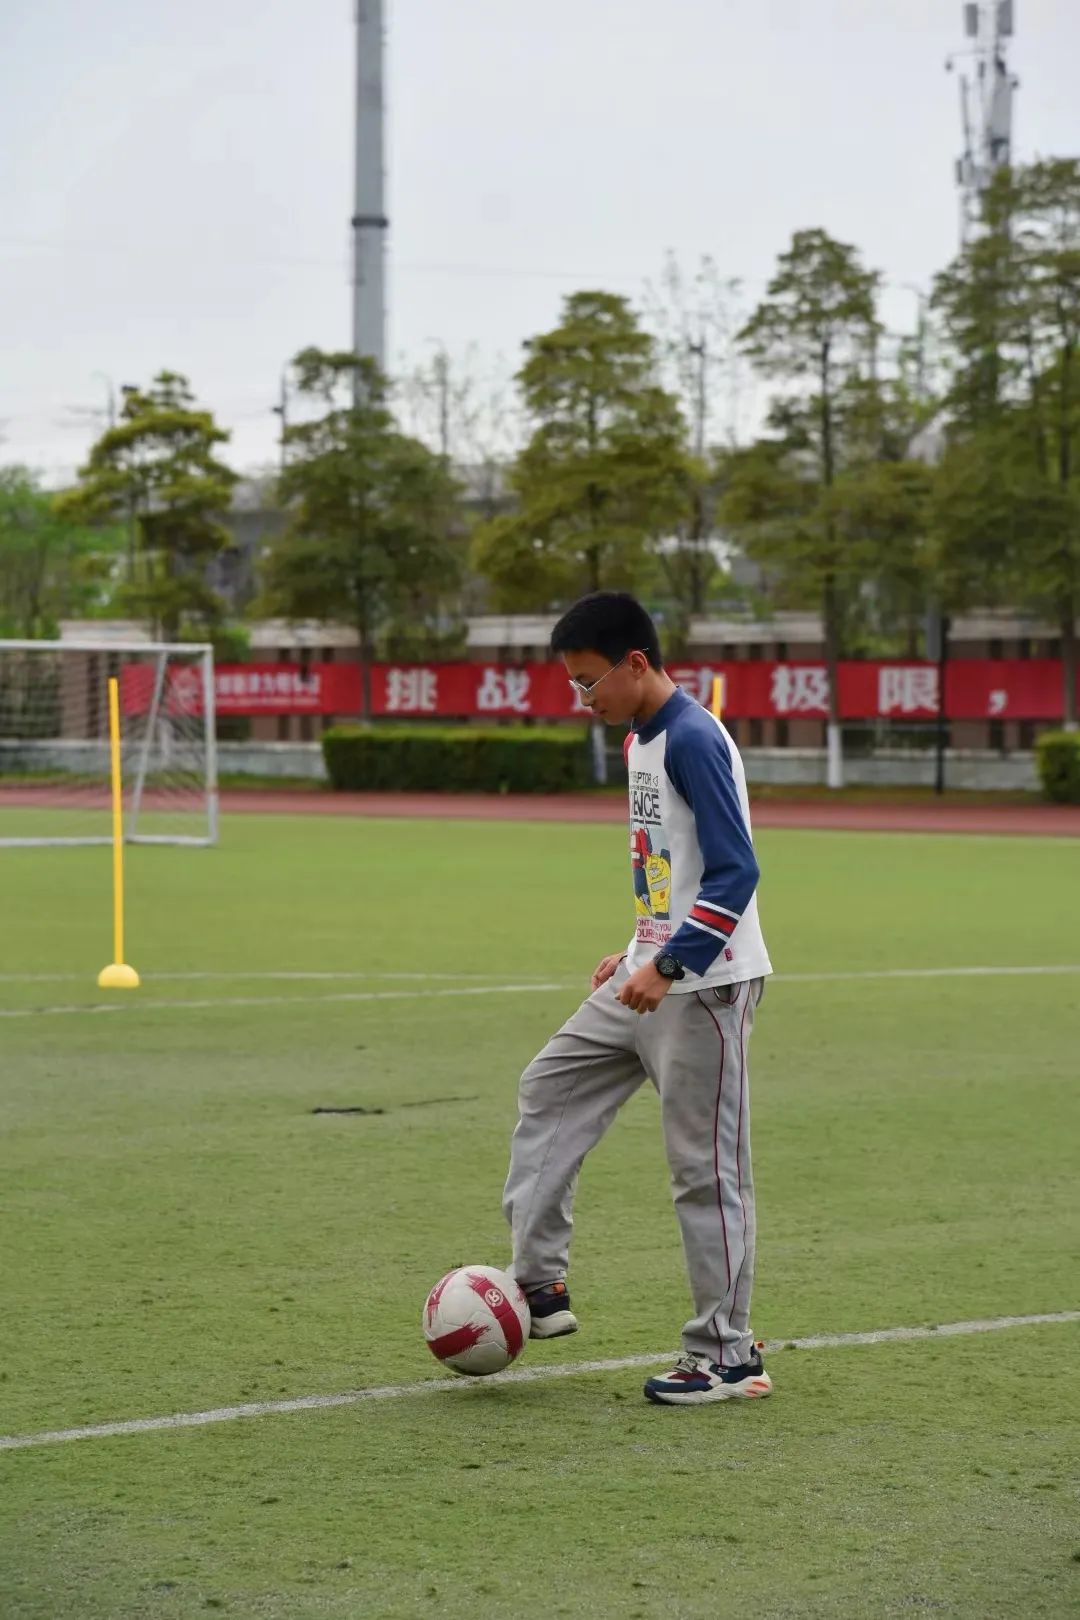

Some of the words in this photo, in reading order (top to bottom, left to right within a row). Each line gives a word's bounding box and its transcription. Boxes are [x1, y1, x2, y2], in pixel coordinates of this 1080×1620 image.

[385, 666, 1008, 714] 挑战动极限，
[632, 790, 661, 820] ENCE
